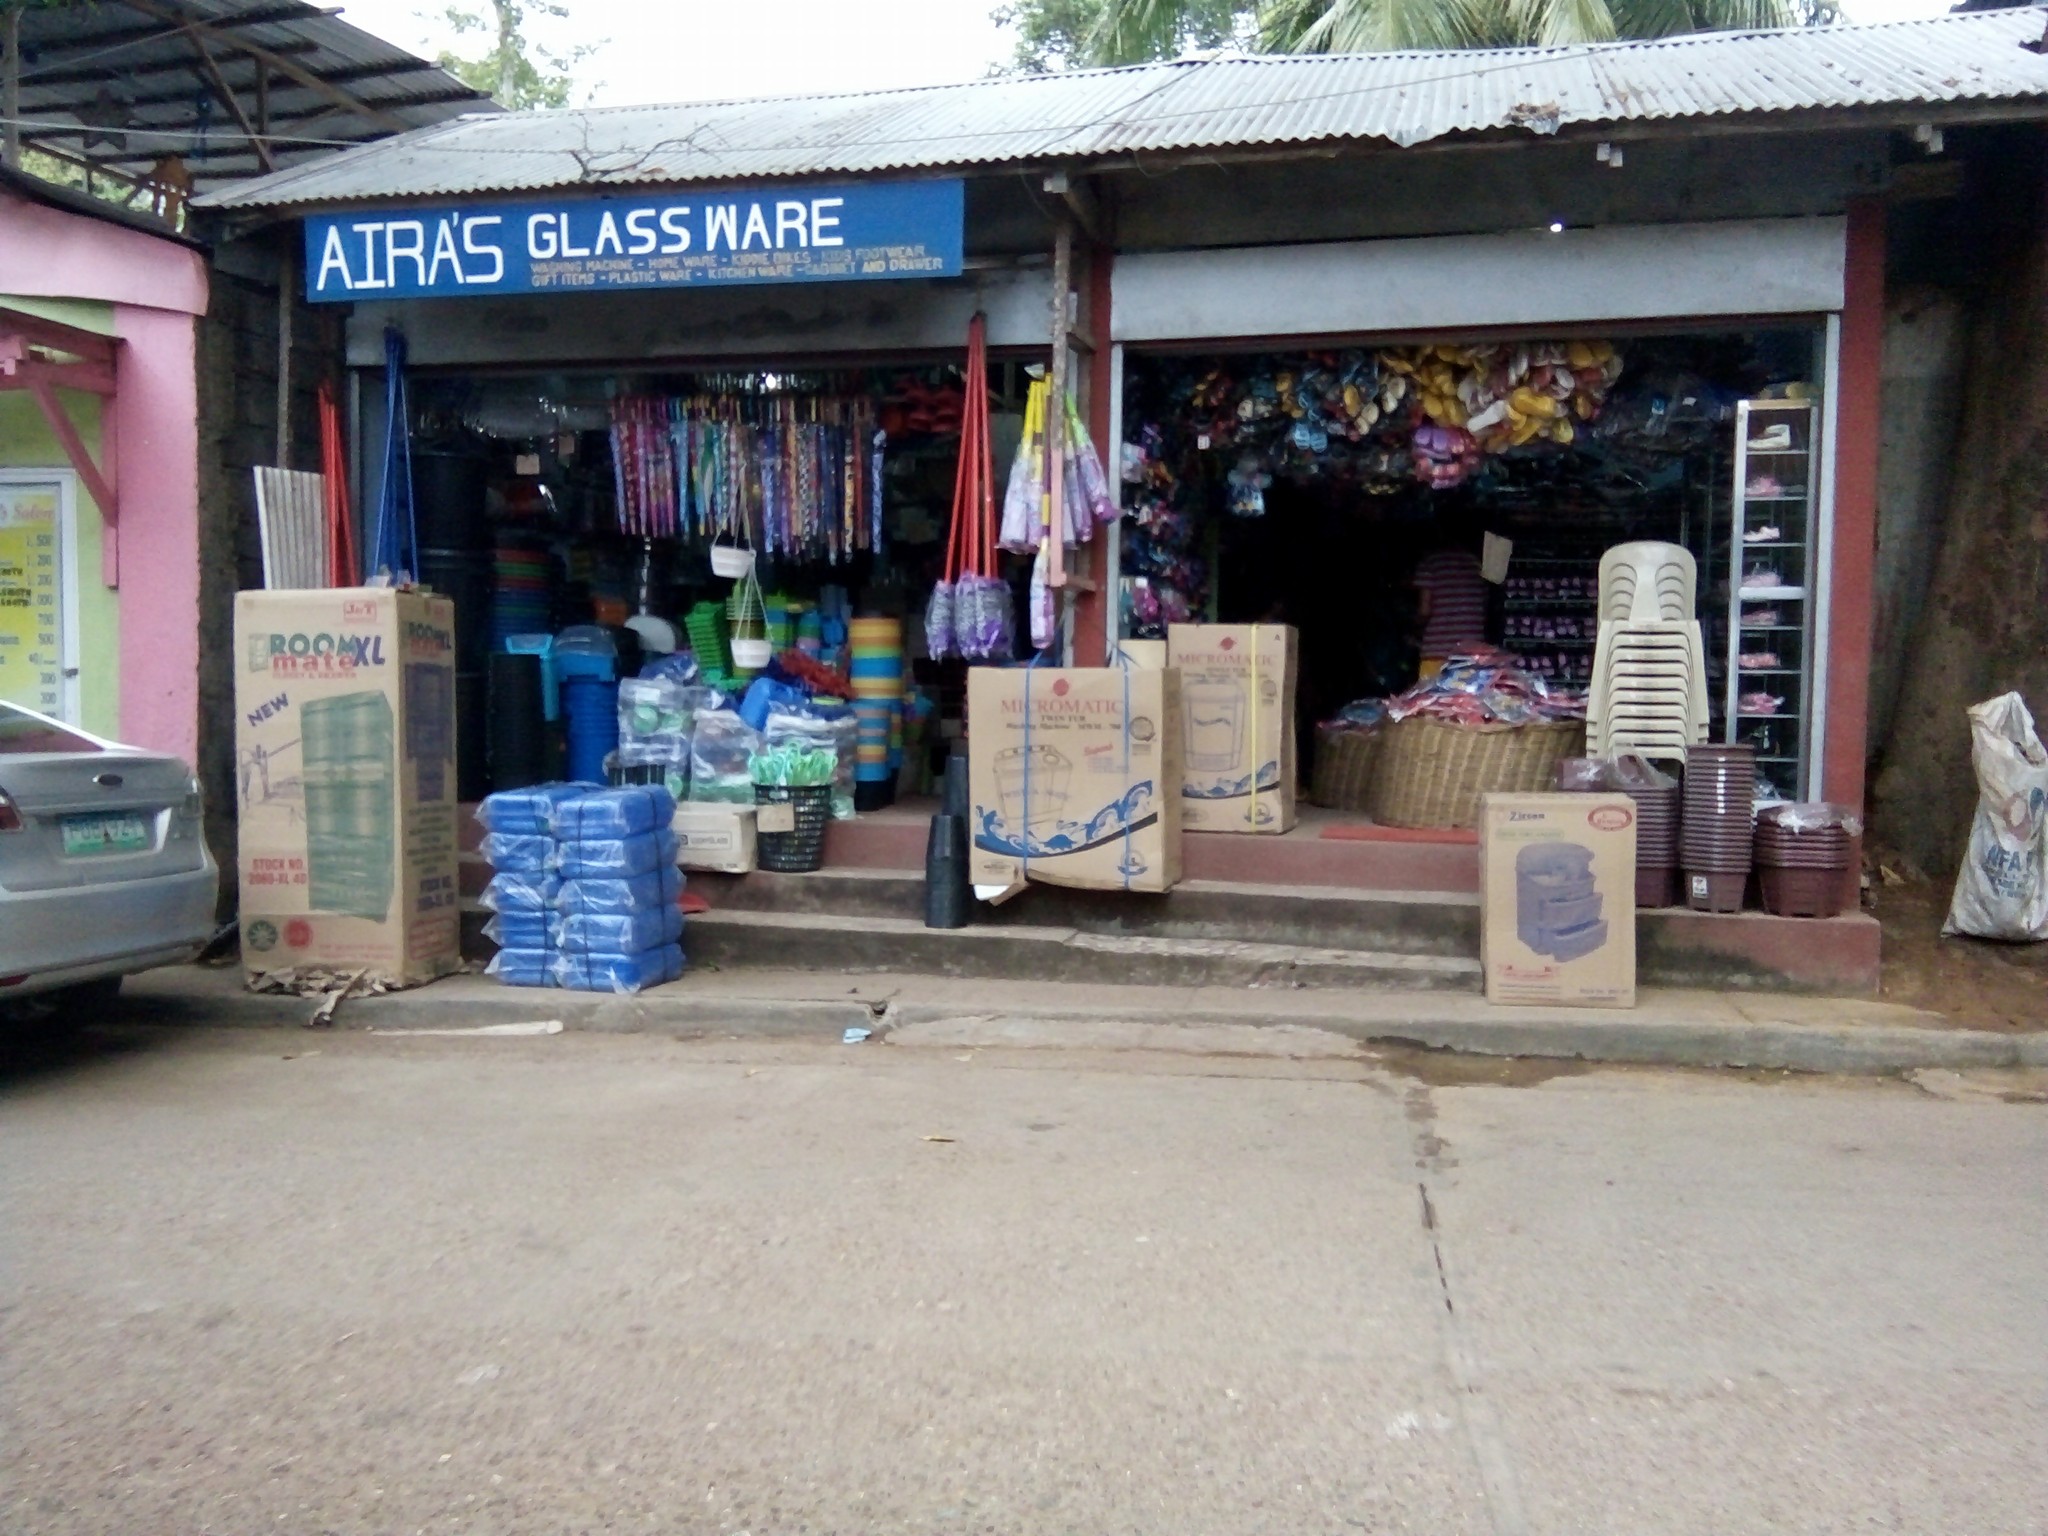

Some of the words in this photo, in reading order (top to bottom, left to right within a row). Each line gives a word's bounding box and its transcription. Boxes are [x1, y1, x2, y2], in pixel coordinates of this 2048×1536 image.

[316, 211, 504, 291] AIRA'S
[527, 207, 691, 259] GLASS
[705, 197, 844, 251] WARE
[531, 272, 558, 288] GIFT
[561, 272, 595, 287] ITEMS
[608, 270, 656, 284] PLASTIC
[659, 269, 693, 282] WARE
[708, 266, 756, 280] KITCHEN
[758, 264, 794, 278] WARE
[862, 260, 886, 274] AND
[889, 257, 944, 272] DRAWER
[270, 633, 357, 657] ROOM
[352, 635, 386, 667] XL
[272, 651, 356, 671] mate
[247, 693, 288, 727] NEW
